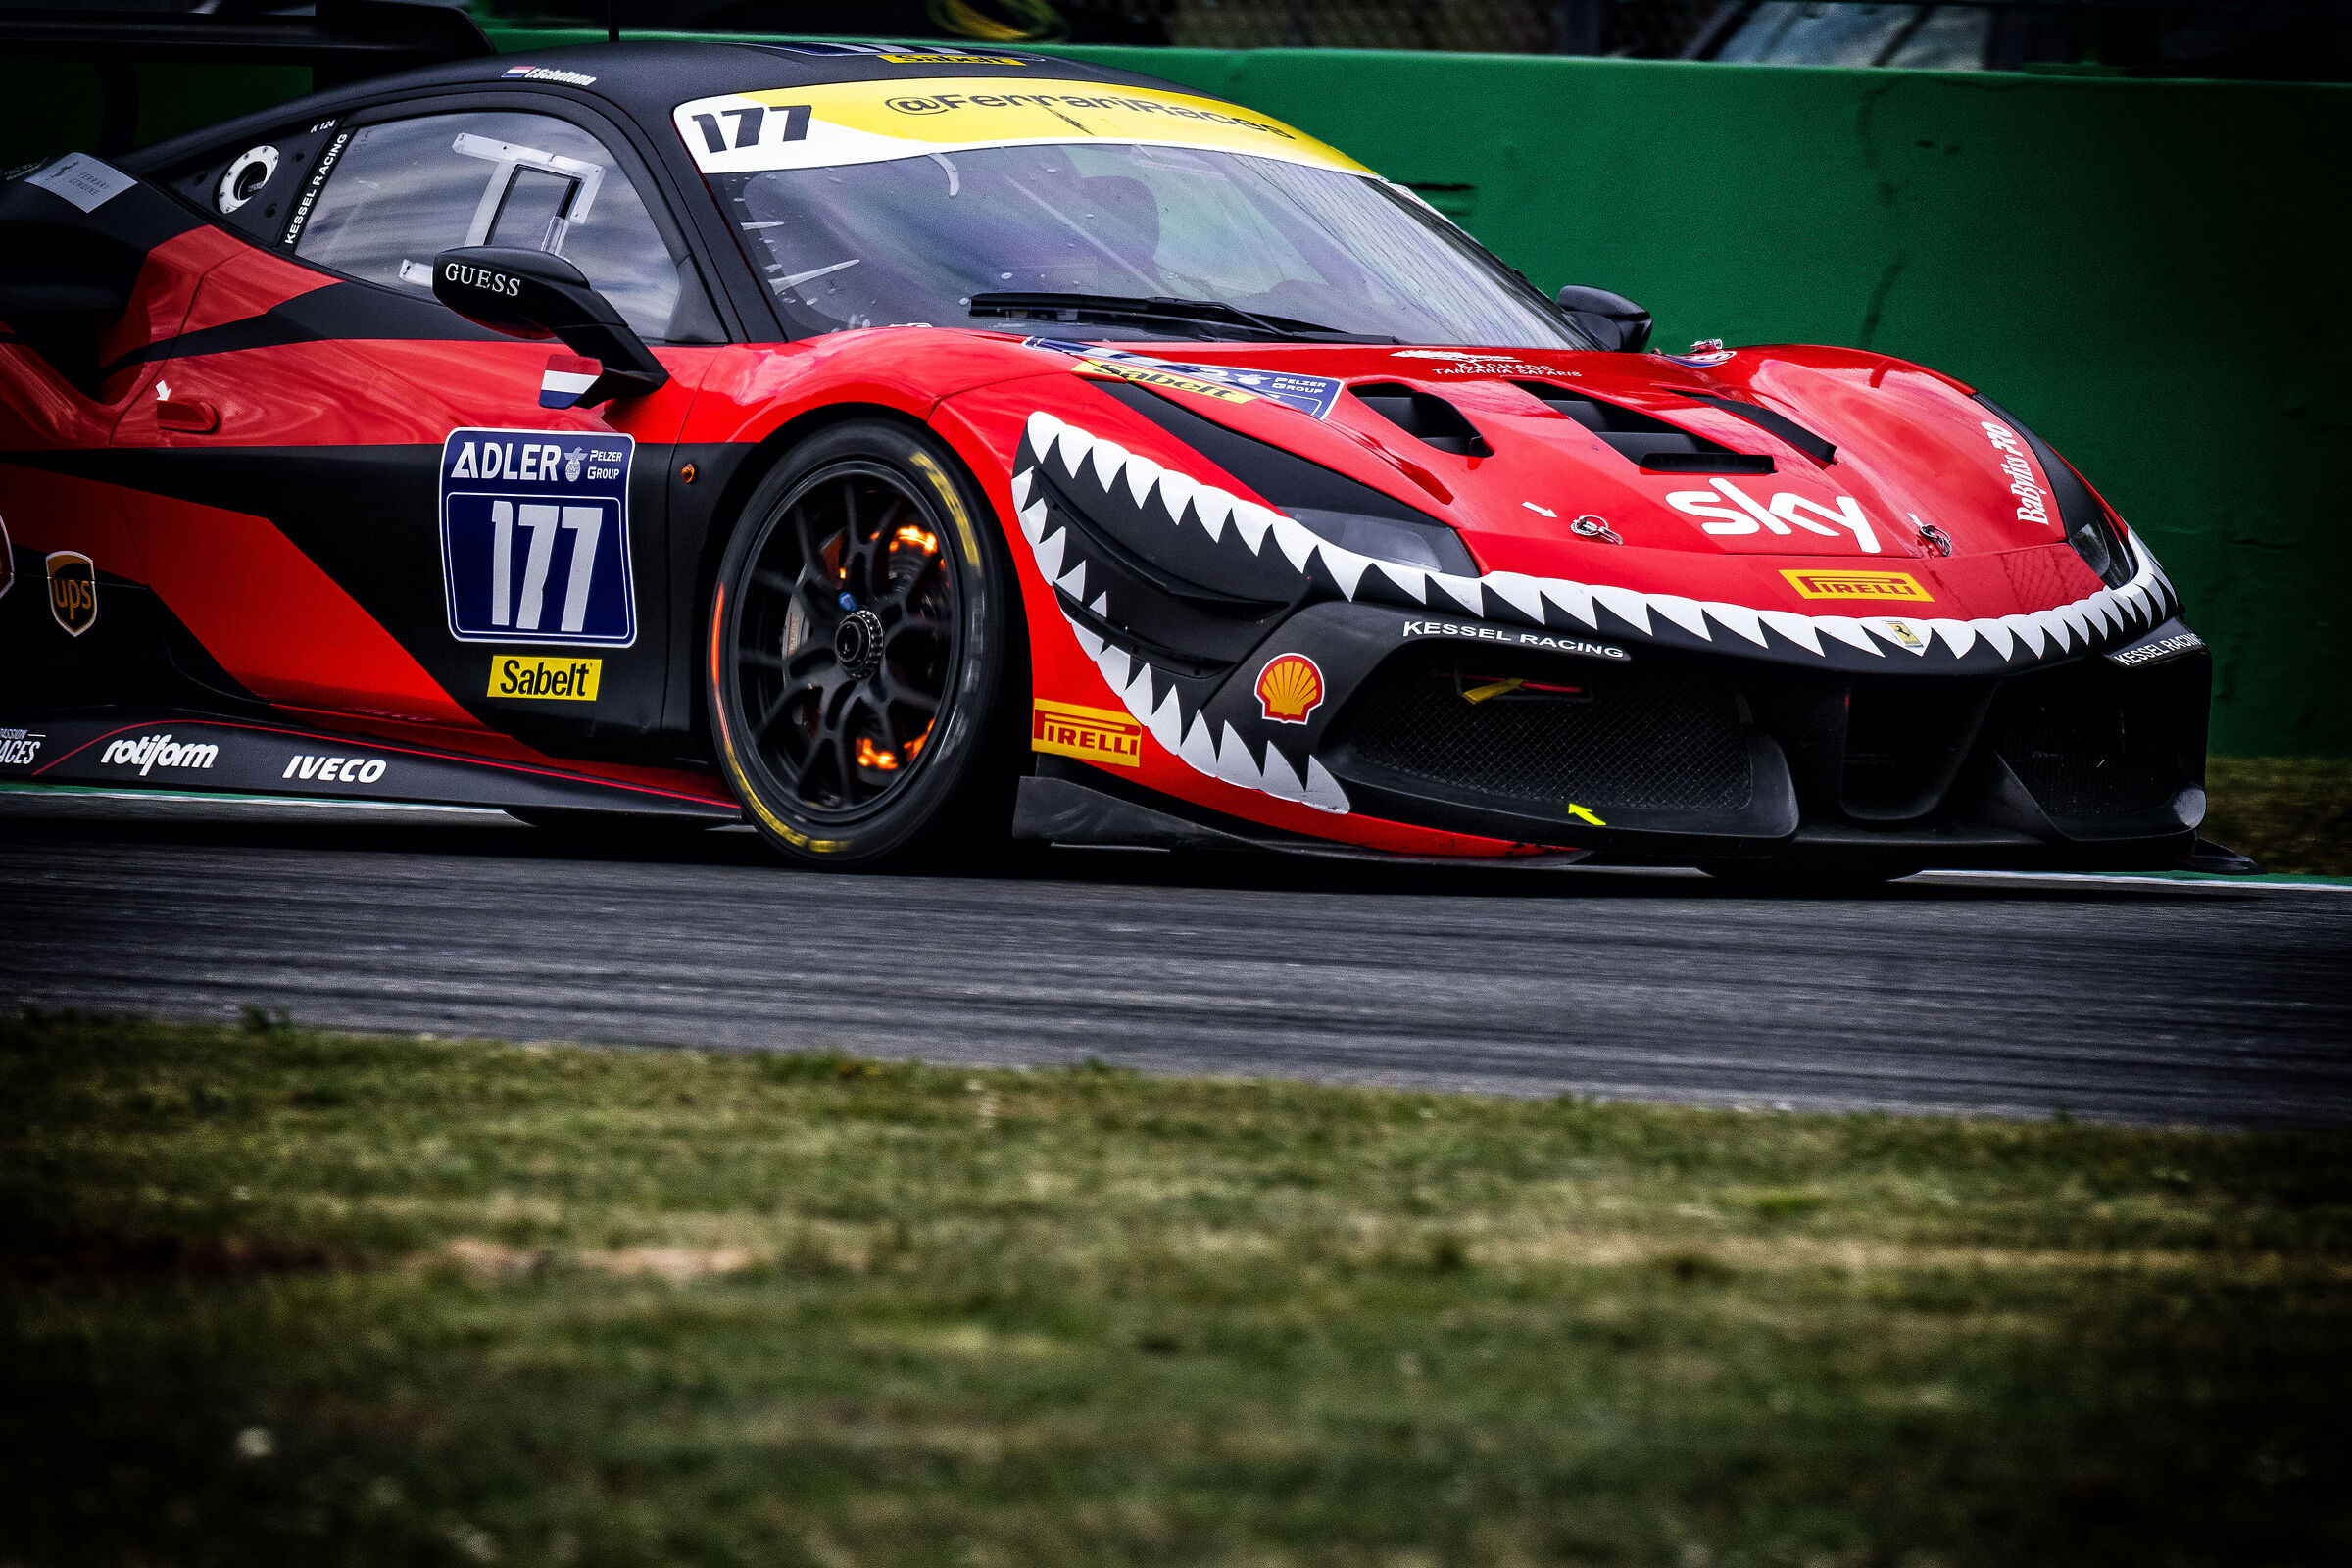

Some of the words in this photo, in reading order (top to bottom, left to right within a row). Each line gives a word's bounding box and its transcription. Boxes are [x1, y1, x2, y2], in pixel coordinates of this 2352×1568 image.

[691, 104, 813, 154] 177
[884, 93, 1296, 140] @FerrariRaces
[284, 188, 317, 245] KESSEL
[312, 133, 348, 186] RACING
[445, 263, 521, 297] GUESS
[1094, 364, 1237, 398] Sabelt
[1271, 382, 1324, 394] GROUP
[1274, 376, 1327, 388] PELZER
[450, 441, 562, 482] ADLER
[587, 466, 620, 480] GROUP
[589, 449, 623, 463] PELZER
[1665, 477, 1882, 554] sky
[491, 500, 604, 633] 177
[54, 579, 92, 620] ups
[1796, 576, 1917, 596] PIRELLI
[1402, 620, 1512, 642] KESSEL
[1519, 633, 1625, 659] RACING
[2114, 643, 2170, 666] KESSEL
[499, 659, 592, 697] Sabelt
[1033, 709, 1141, 756] PIRELLI
[0, 739, 41, 765] ACES
[100, 734, 220, 777] rotiform
[282, 755, 387, 784] IVECO
